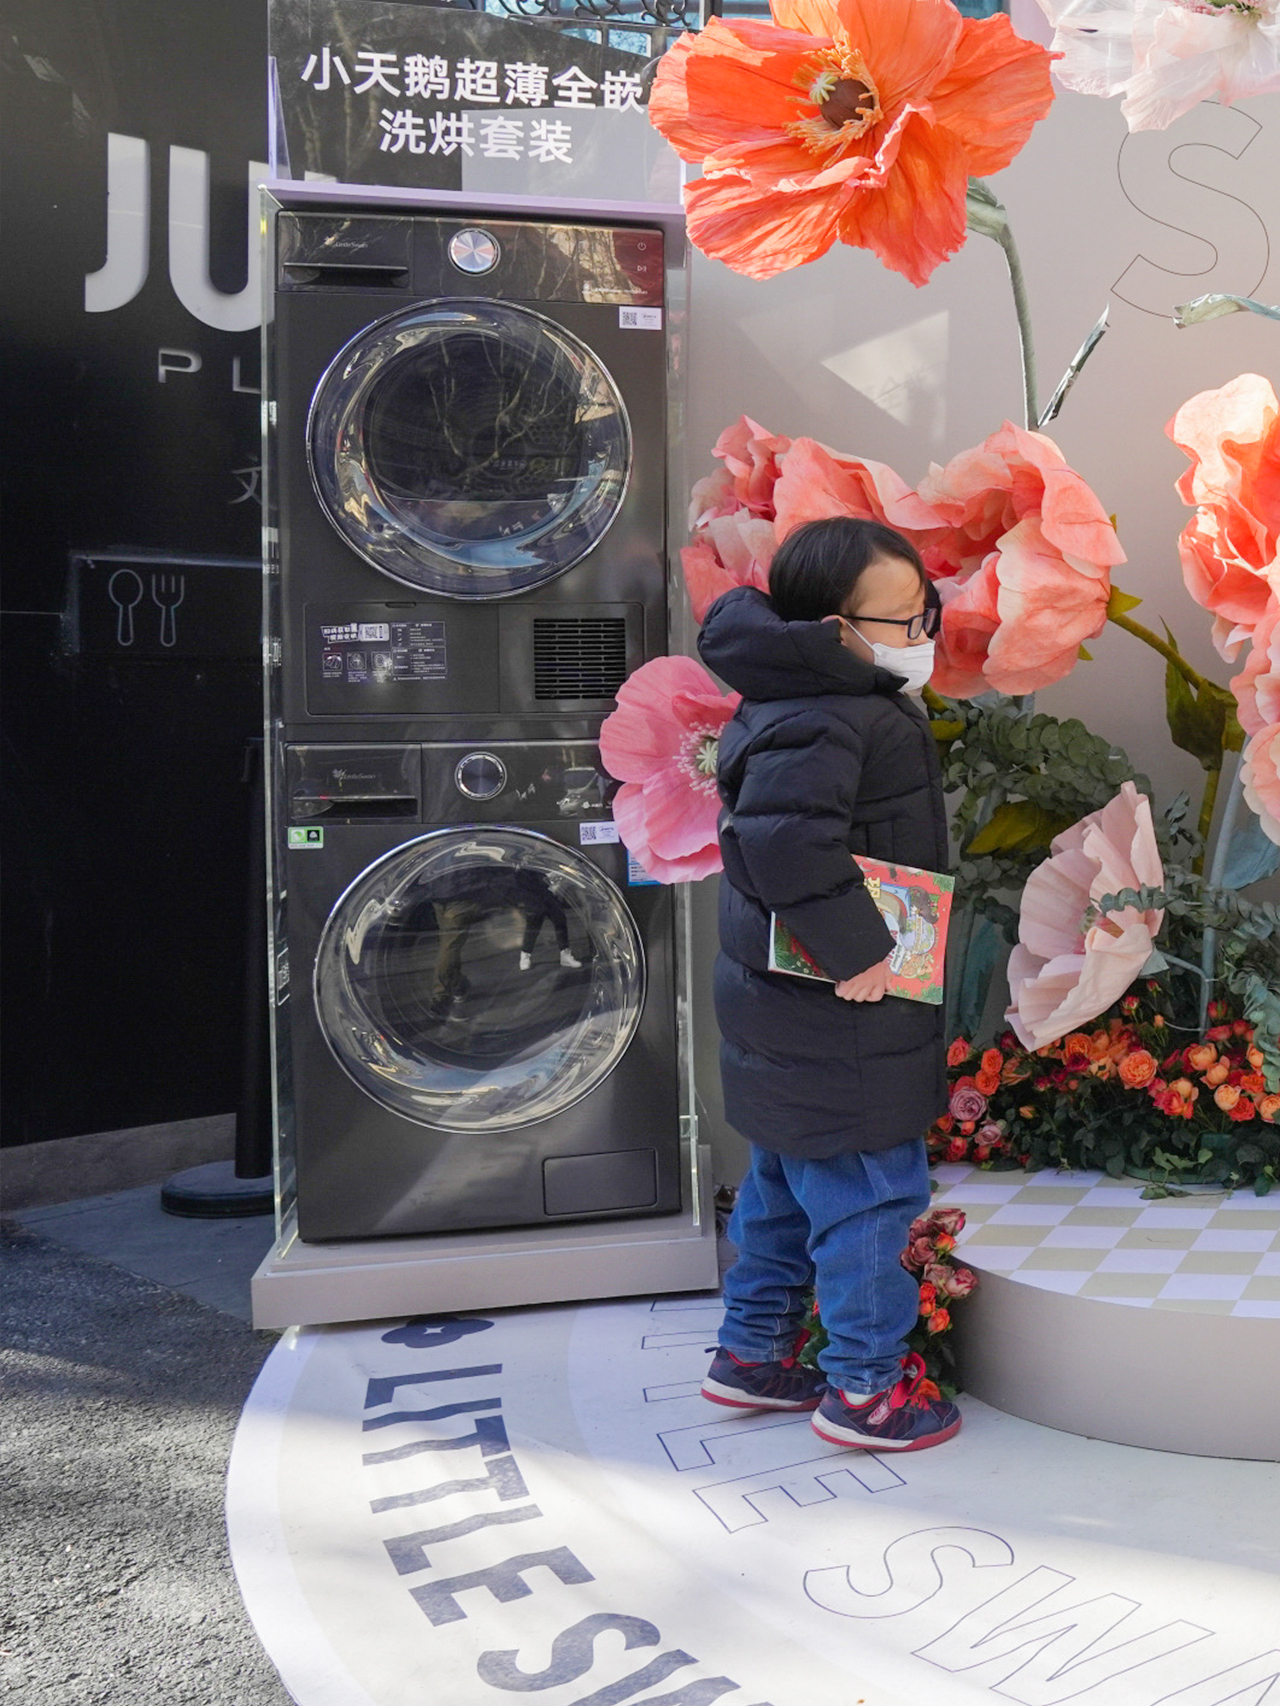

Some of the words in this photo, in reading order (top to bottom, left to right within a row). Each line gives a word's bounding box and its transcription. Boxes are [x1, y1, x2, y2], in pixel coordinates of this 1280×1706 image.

[301, 47, 645, 114] 小天鹅超薄全嵌
[379, 109, 574, 164] 洗烘套装
[85, 132, 337, 332] JU
